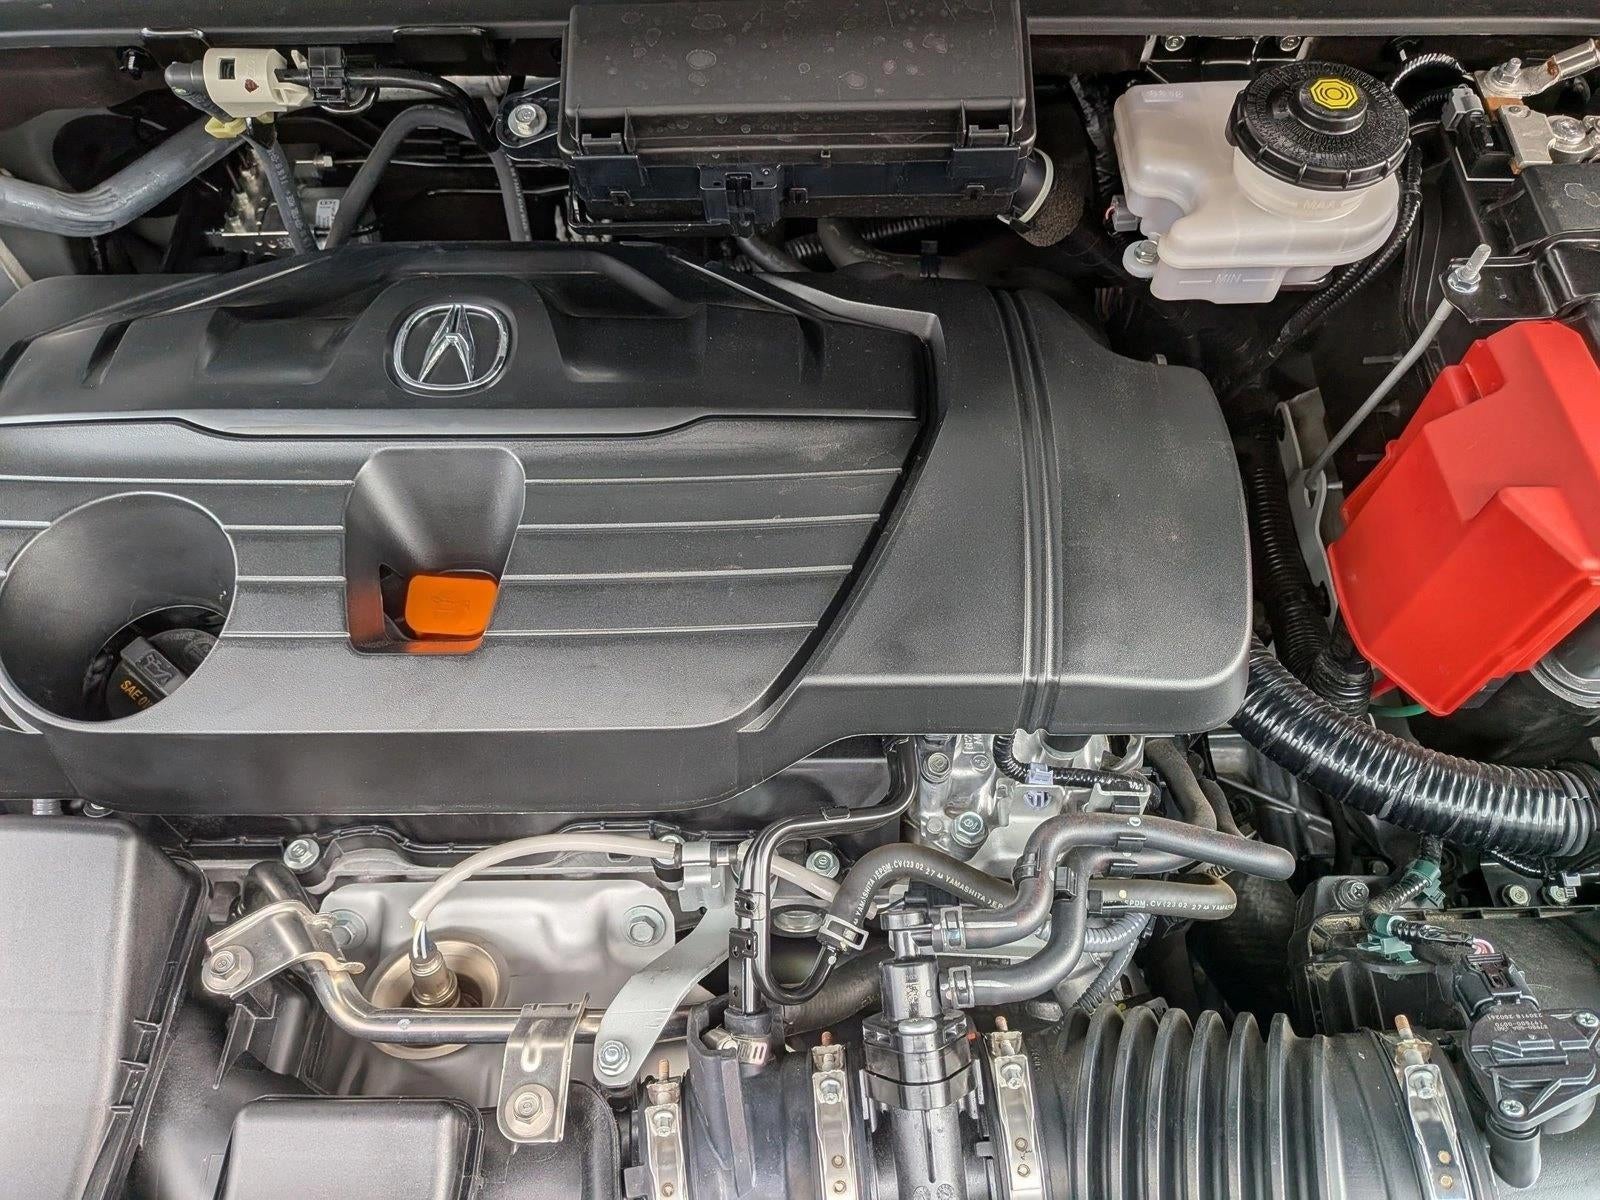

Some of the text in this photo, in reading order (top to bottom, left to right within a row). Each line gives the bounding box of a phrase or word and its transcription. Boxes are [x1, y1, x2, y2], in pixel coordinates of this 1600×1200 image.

[1215, 273, 1242, 284] MIN
[120, 680, 143, 700] SAE
[856, 878, 876, 916] YAMASHITA
[925, 868, 936, 877] 27
[945, 875, 986, 902] YAMASHITA
